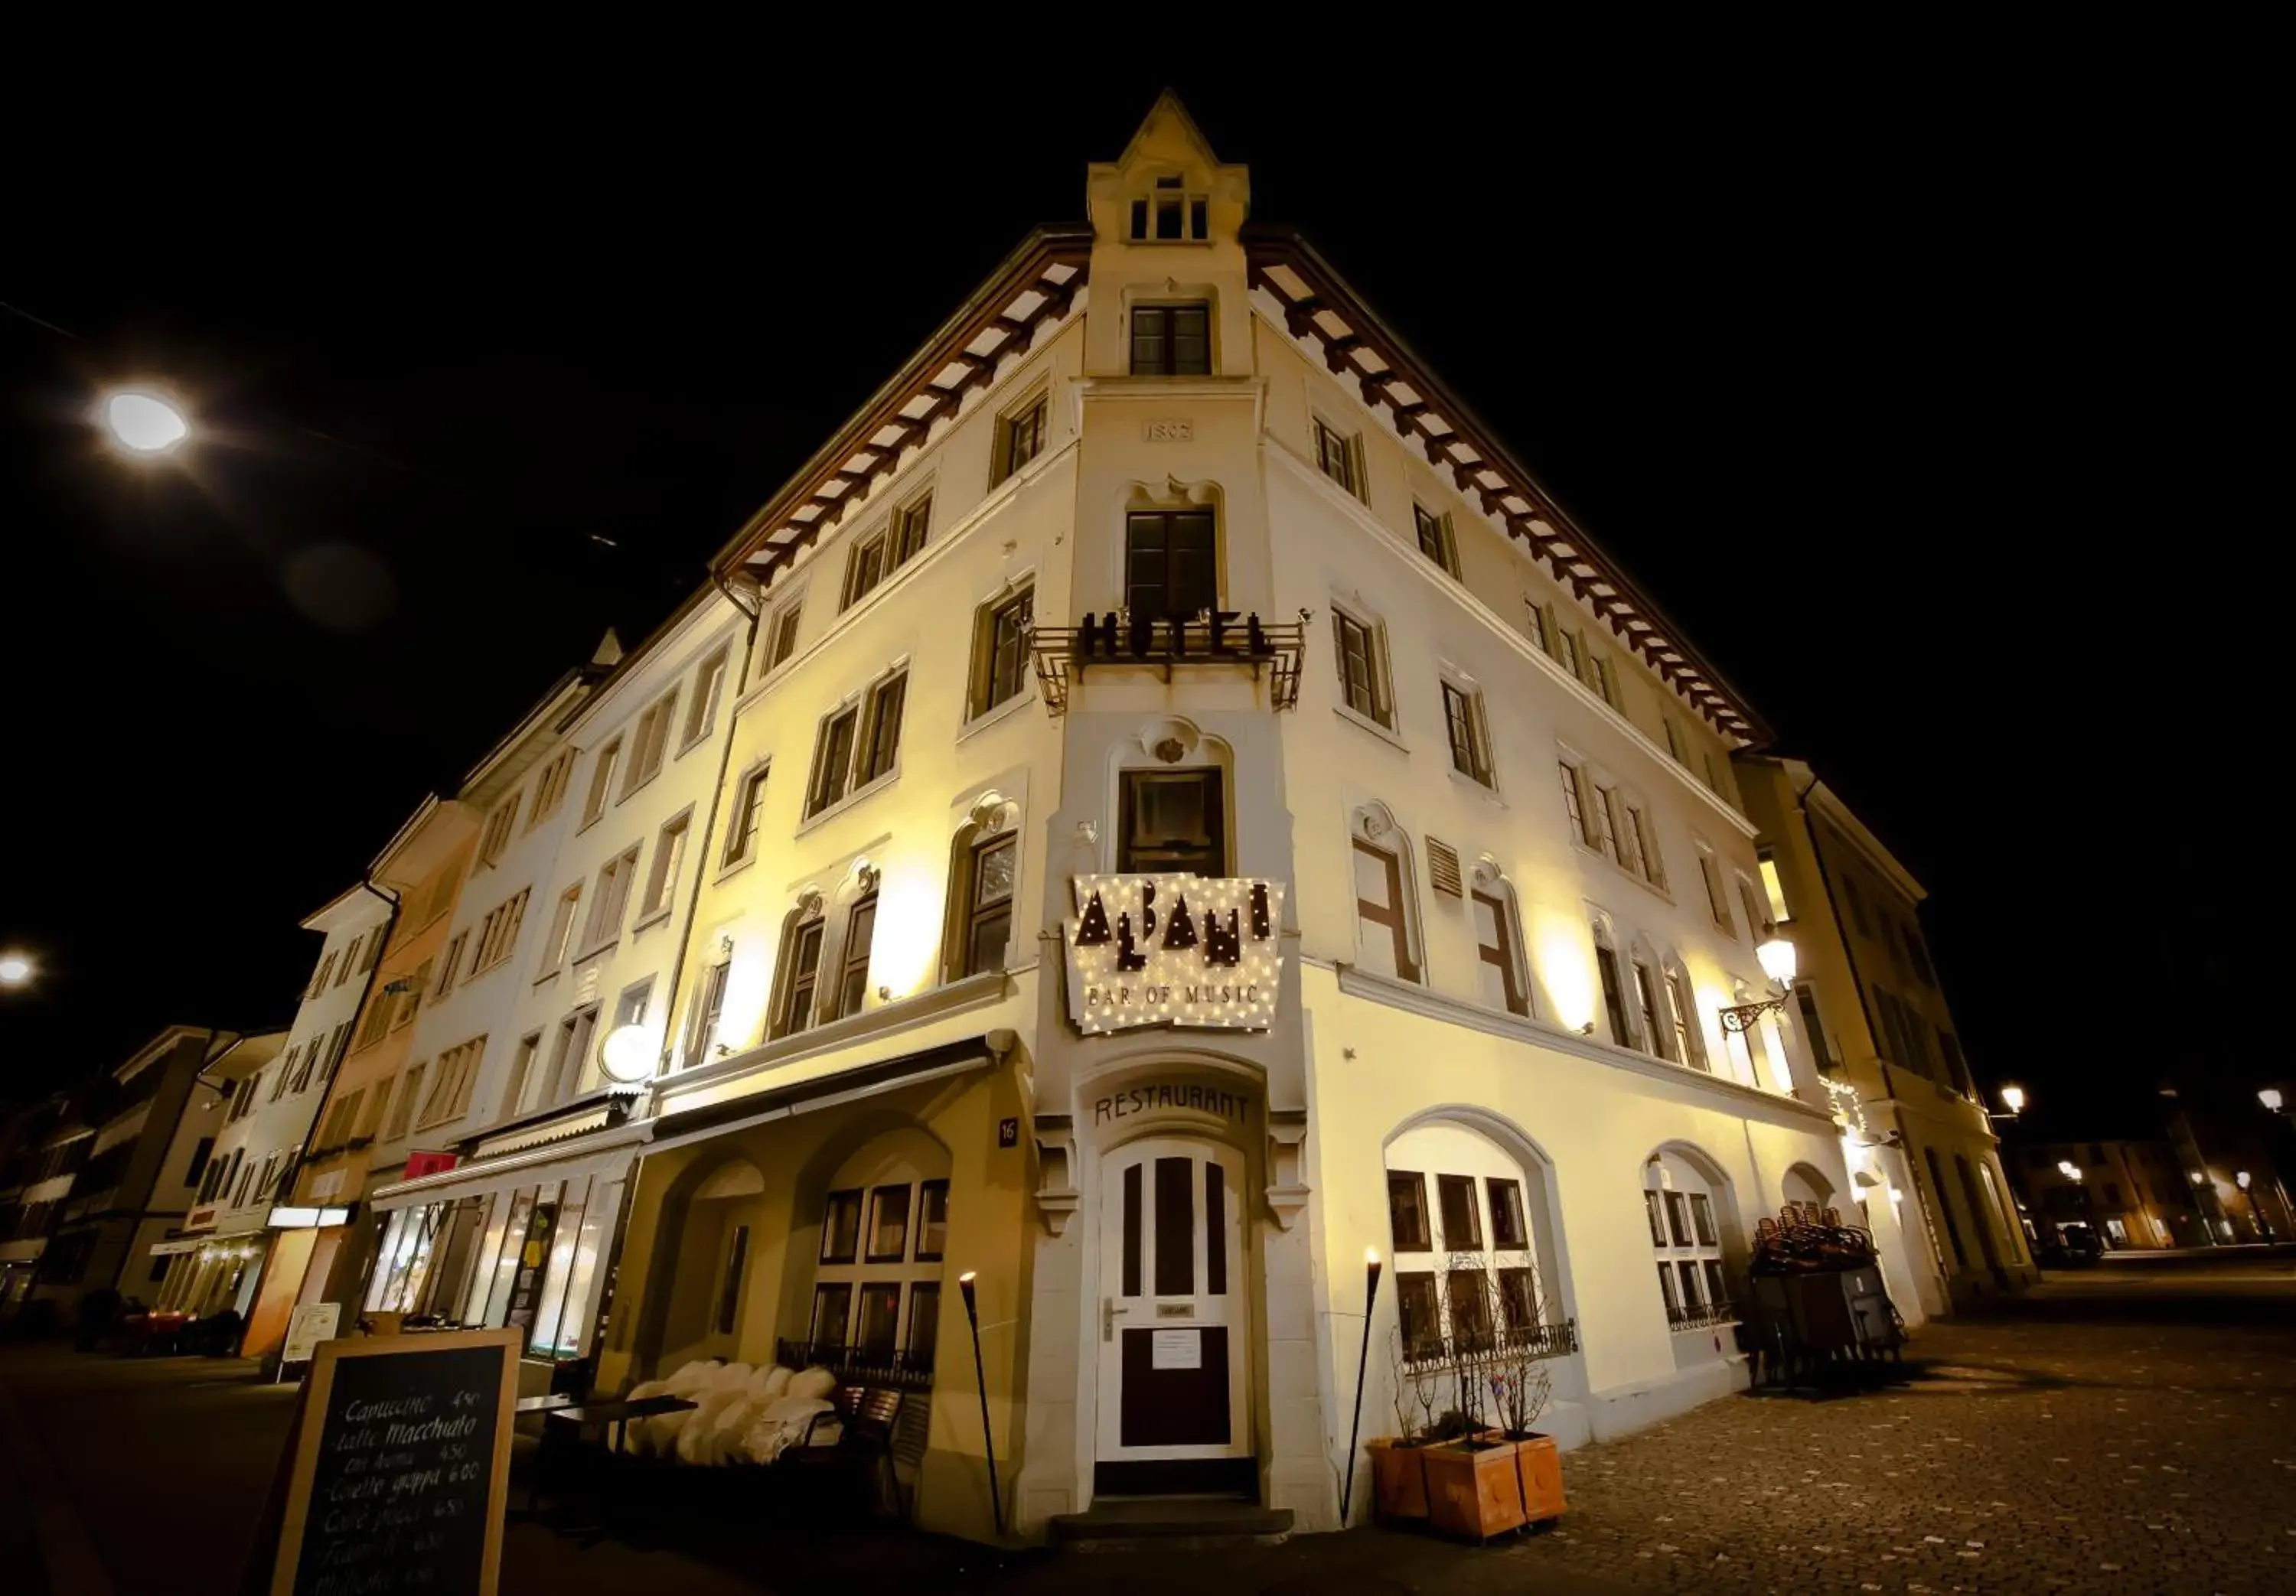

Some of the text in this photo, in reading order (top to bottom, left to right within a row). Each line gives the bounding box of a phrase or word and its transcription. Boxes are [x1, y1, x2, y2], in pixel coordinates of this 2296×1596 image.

[1078, 611, 1275, 659] HOTEL
[1075, 881, 1270, 972] ALBANI
[1088, 985, 1259, 1006] BAR OF MUSIC
[1095, 1084, 1248, 1128] RESTAURANT
[1002, 1121, 1015, 1139] 16
[385, 1414, 478, 1446] Macchiato
